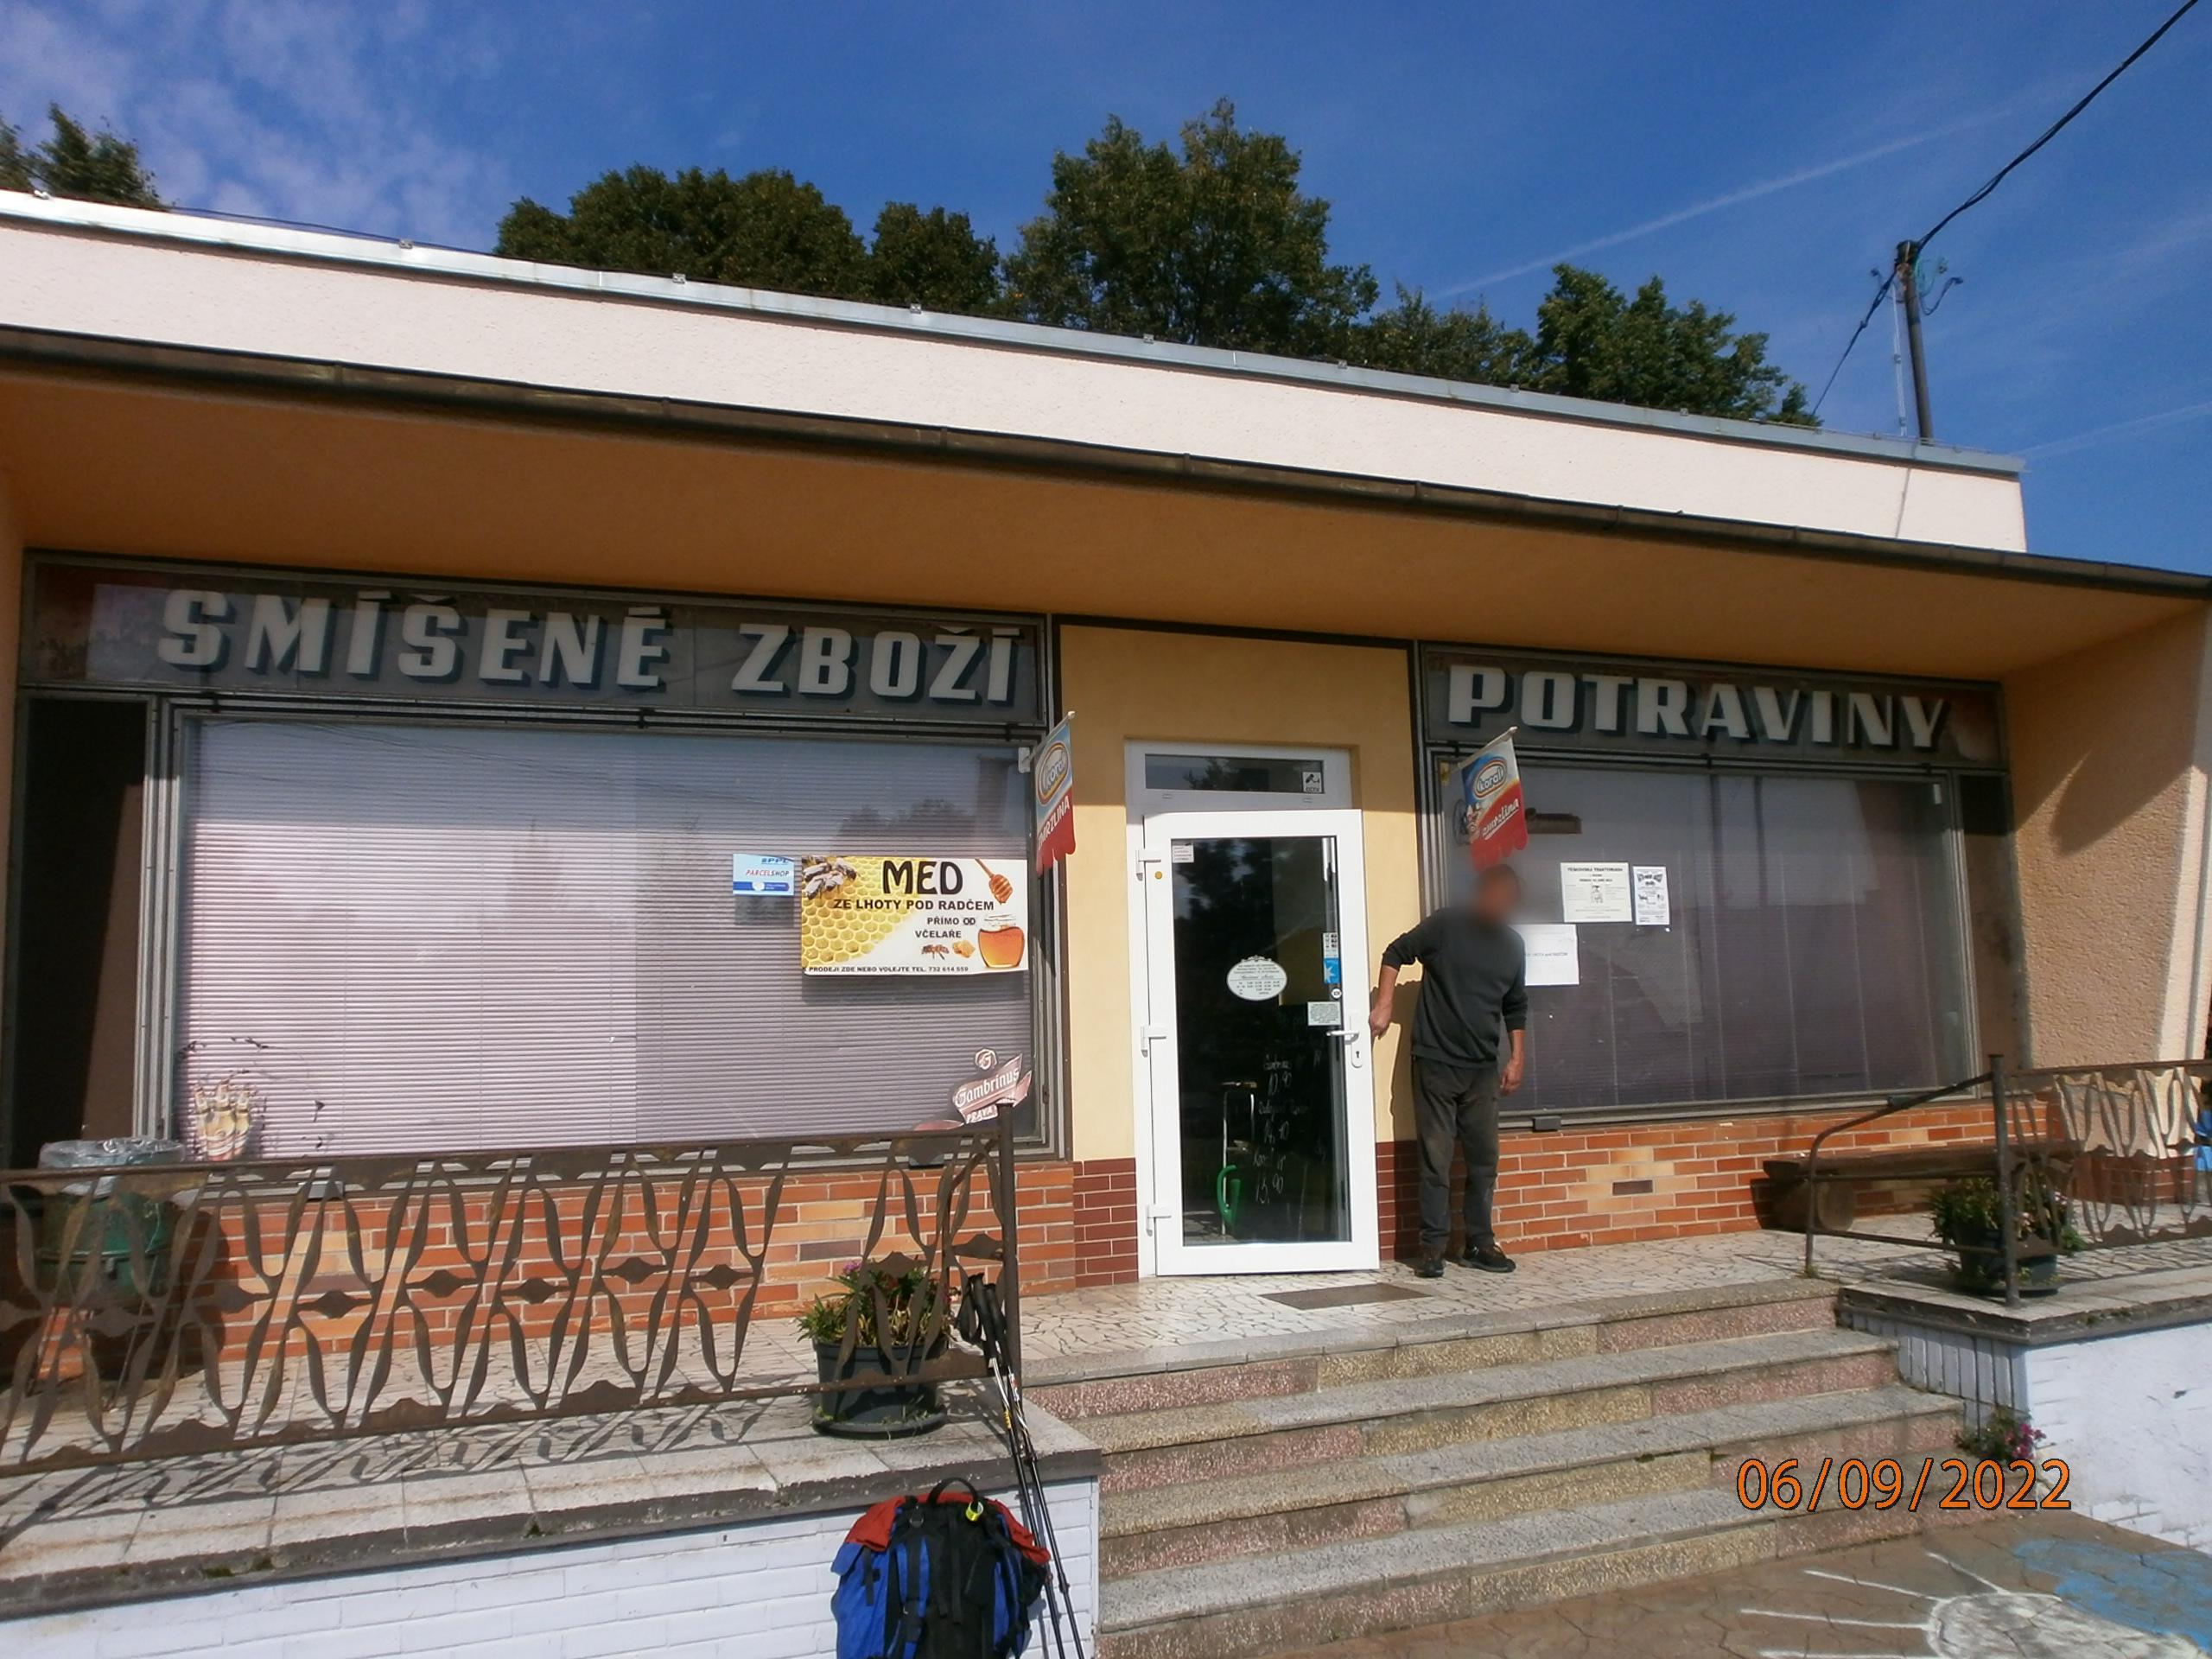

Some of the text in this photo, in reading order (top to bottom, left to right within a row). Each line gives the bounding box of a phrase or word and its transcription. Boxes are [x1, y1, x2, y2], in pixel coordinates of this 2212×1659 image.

[157, 589, 1021, 703] SMÍŠENÉ ZBOŽÍ
[1448, 664, 1945, 748] POTRAVINY
[1478, 767, 1503, 792] koral
[1038, 795, 1070, 851] ZMRZLINA
[882, 860, 963, 895] MED
[834, 899, 995, 911] ZE LHOTY POD RADČEM
[927, 916, 976, 925] PŘÍMO OD
[915, 929, 962, 938] VČELAŘE
[953, 1067, 1020, 1108] Gambrinus
